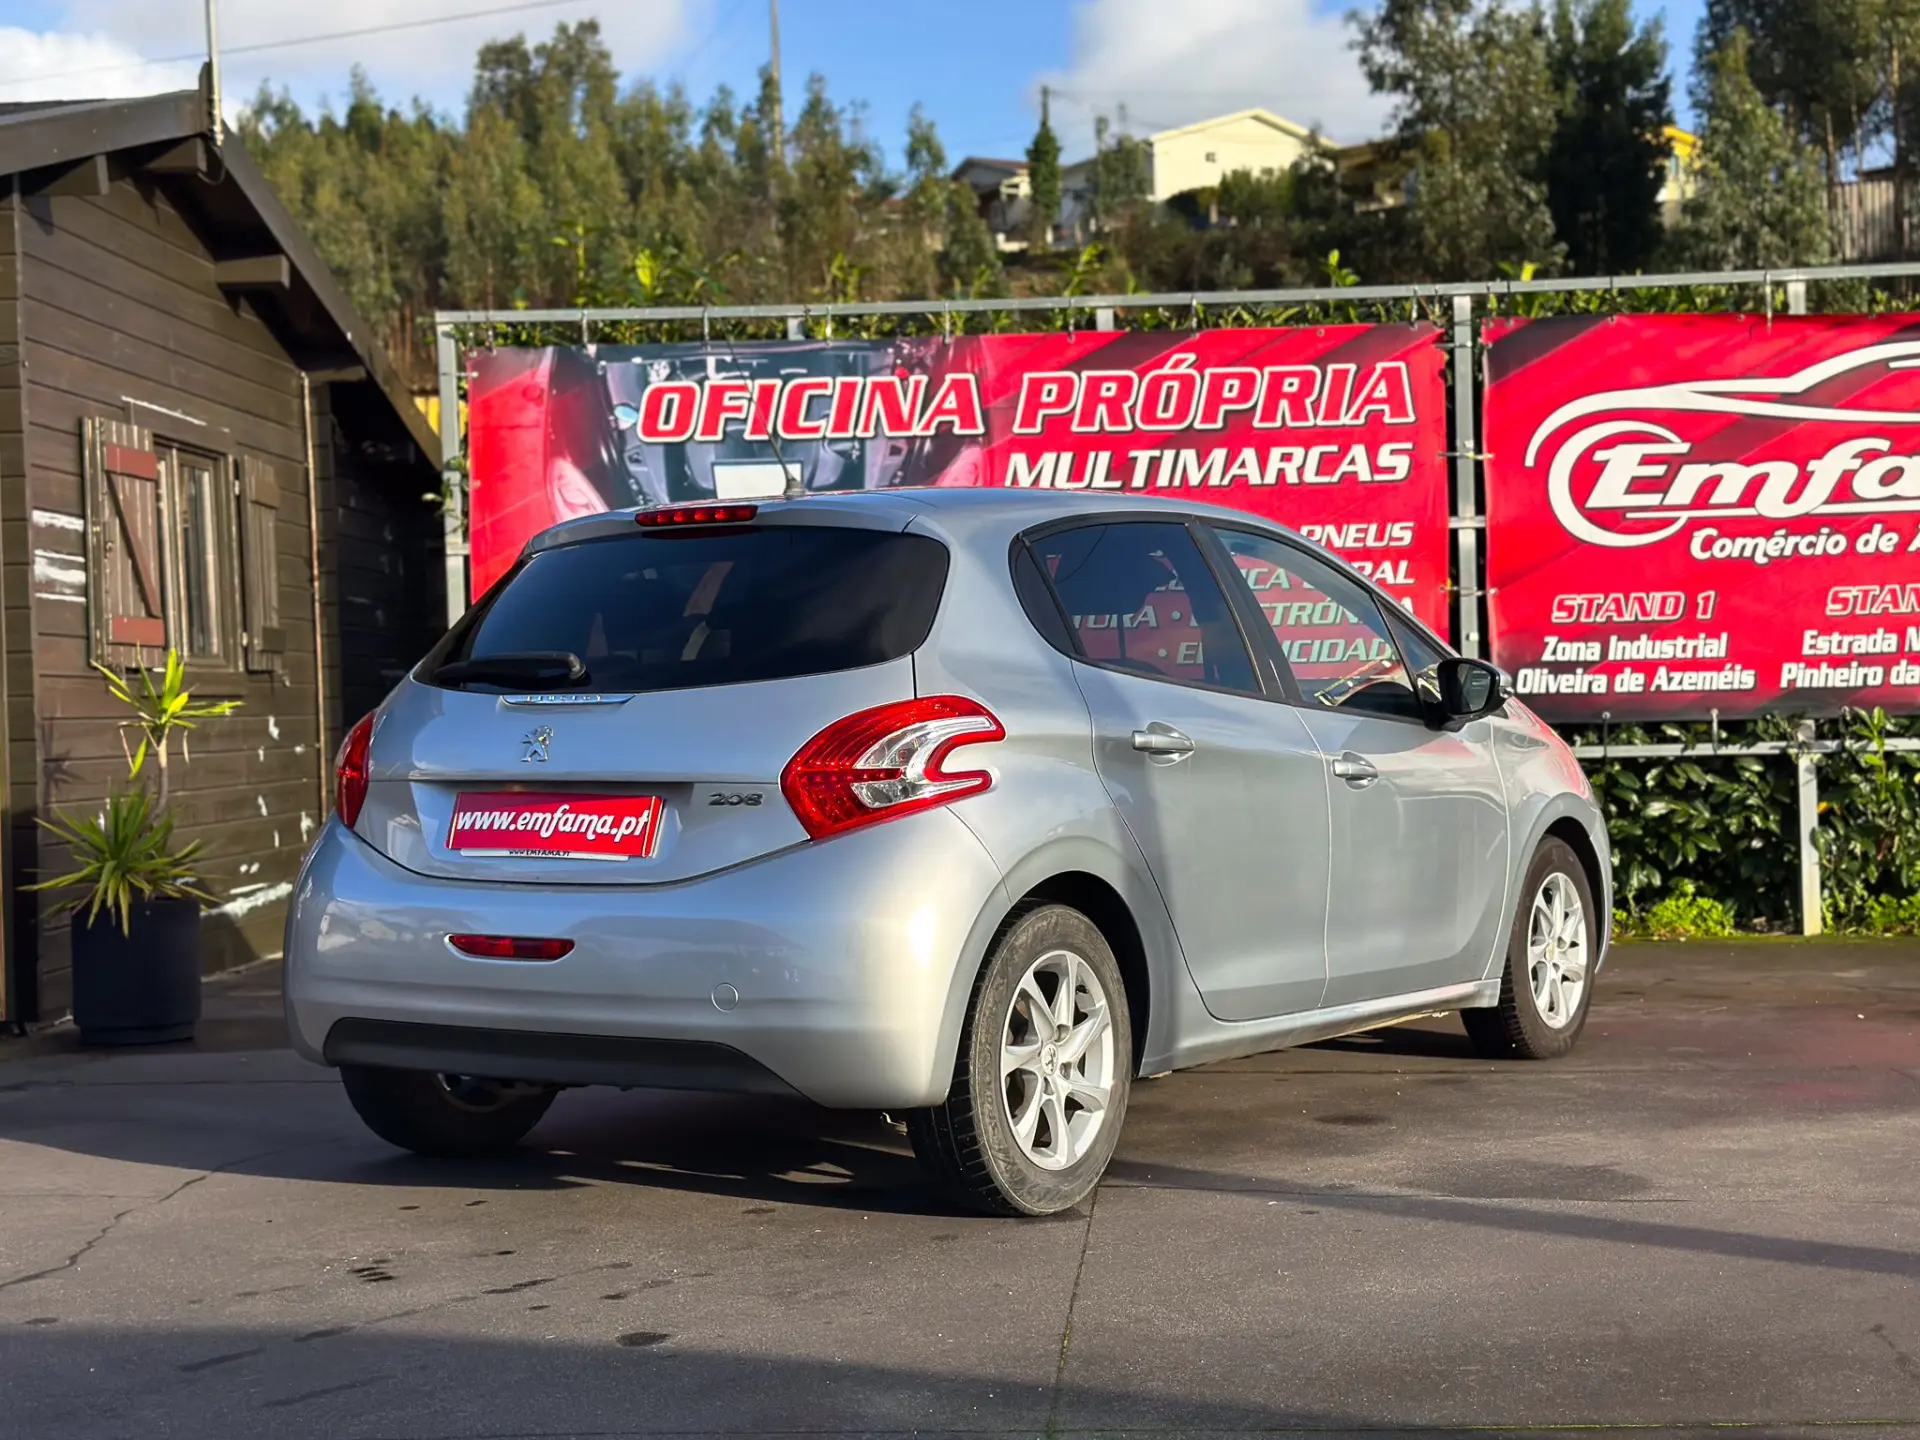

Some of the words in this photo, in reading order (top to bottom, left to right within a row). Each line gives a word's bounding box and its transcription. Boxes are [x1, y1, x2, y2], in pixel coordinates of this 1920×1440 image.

[637, 373, 985, 443] OFICINA
[1013, 353, 1417, 434] PRÓPRIA
[1004, 442, 1414, 489] MULTIMARCAS
[1299, 521, 1415, 548] PNEUS
[1690, 526, 1847, 564] Comércio
[1855, 523, 1900, 553] de
[1550, 592, 1687, 624] STAND
[1696, 590, 1717, 621] 1
[1542, 635, 1601, 662] Zona
[1607, 632, 1729, 661] Industrial
[1802, 627, 1899, 655] Estrada
[1516, 667, 1608, 694] Oliveira
[1614, 666, 1644, 693] de
[1650, 665, 1756, 692] Azeméis
[1780, 661, 1884, 689] Pinheiro
[707, 792, 764, 806] 208
[456, 803, 650, 843] www.emfama.pt
